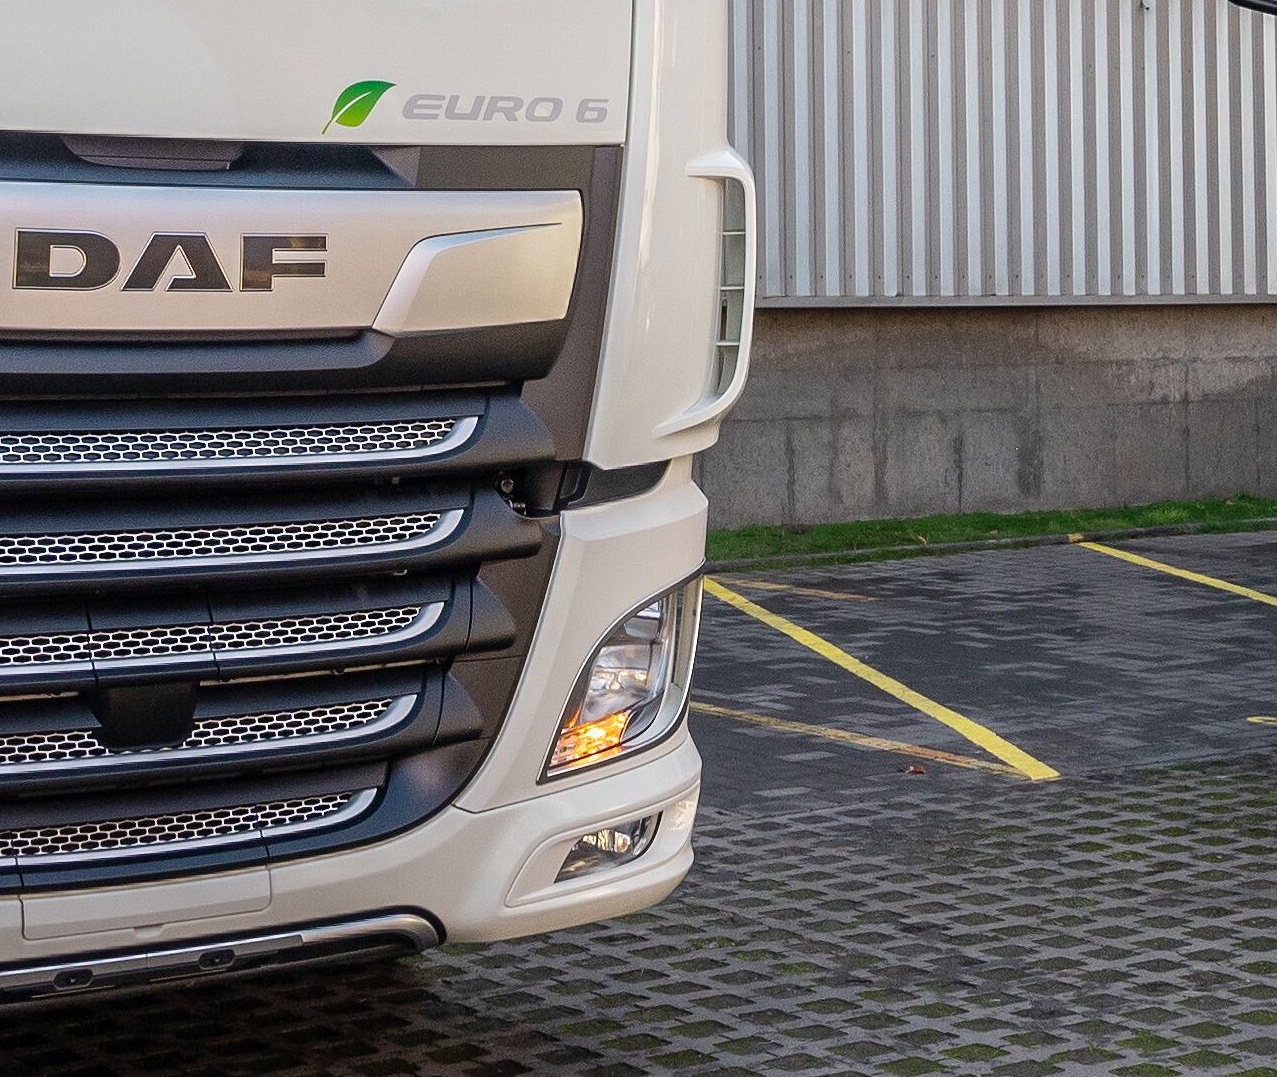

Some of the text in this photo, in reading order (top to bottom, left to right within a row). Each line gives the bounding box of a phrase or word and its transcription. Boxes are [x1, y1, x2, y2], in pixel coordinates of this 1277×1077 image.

[402, 93, 610, 123] EURO 6
[12, 227, 328, 292] DAF
